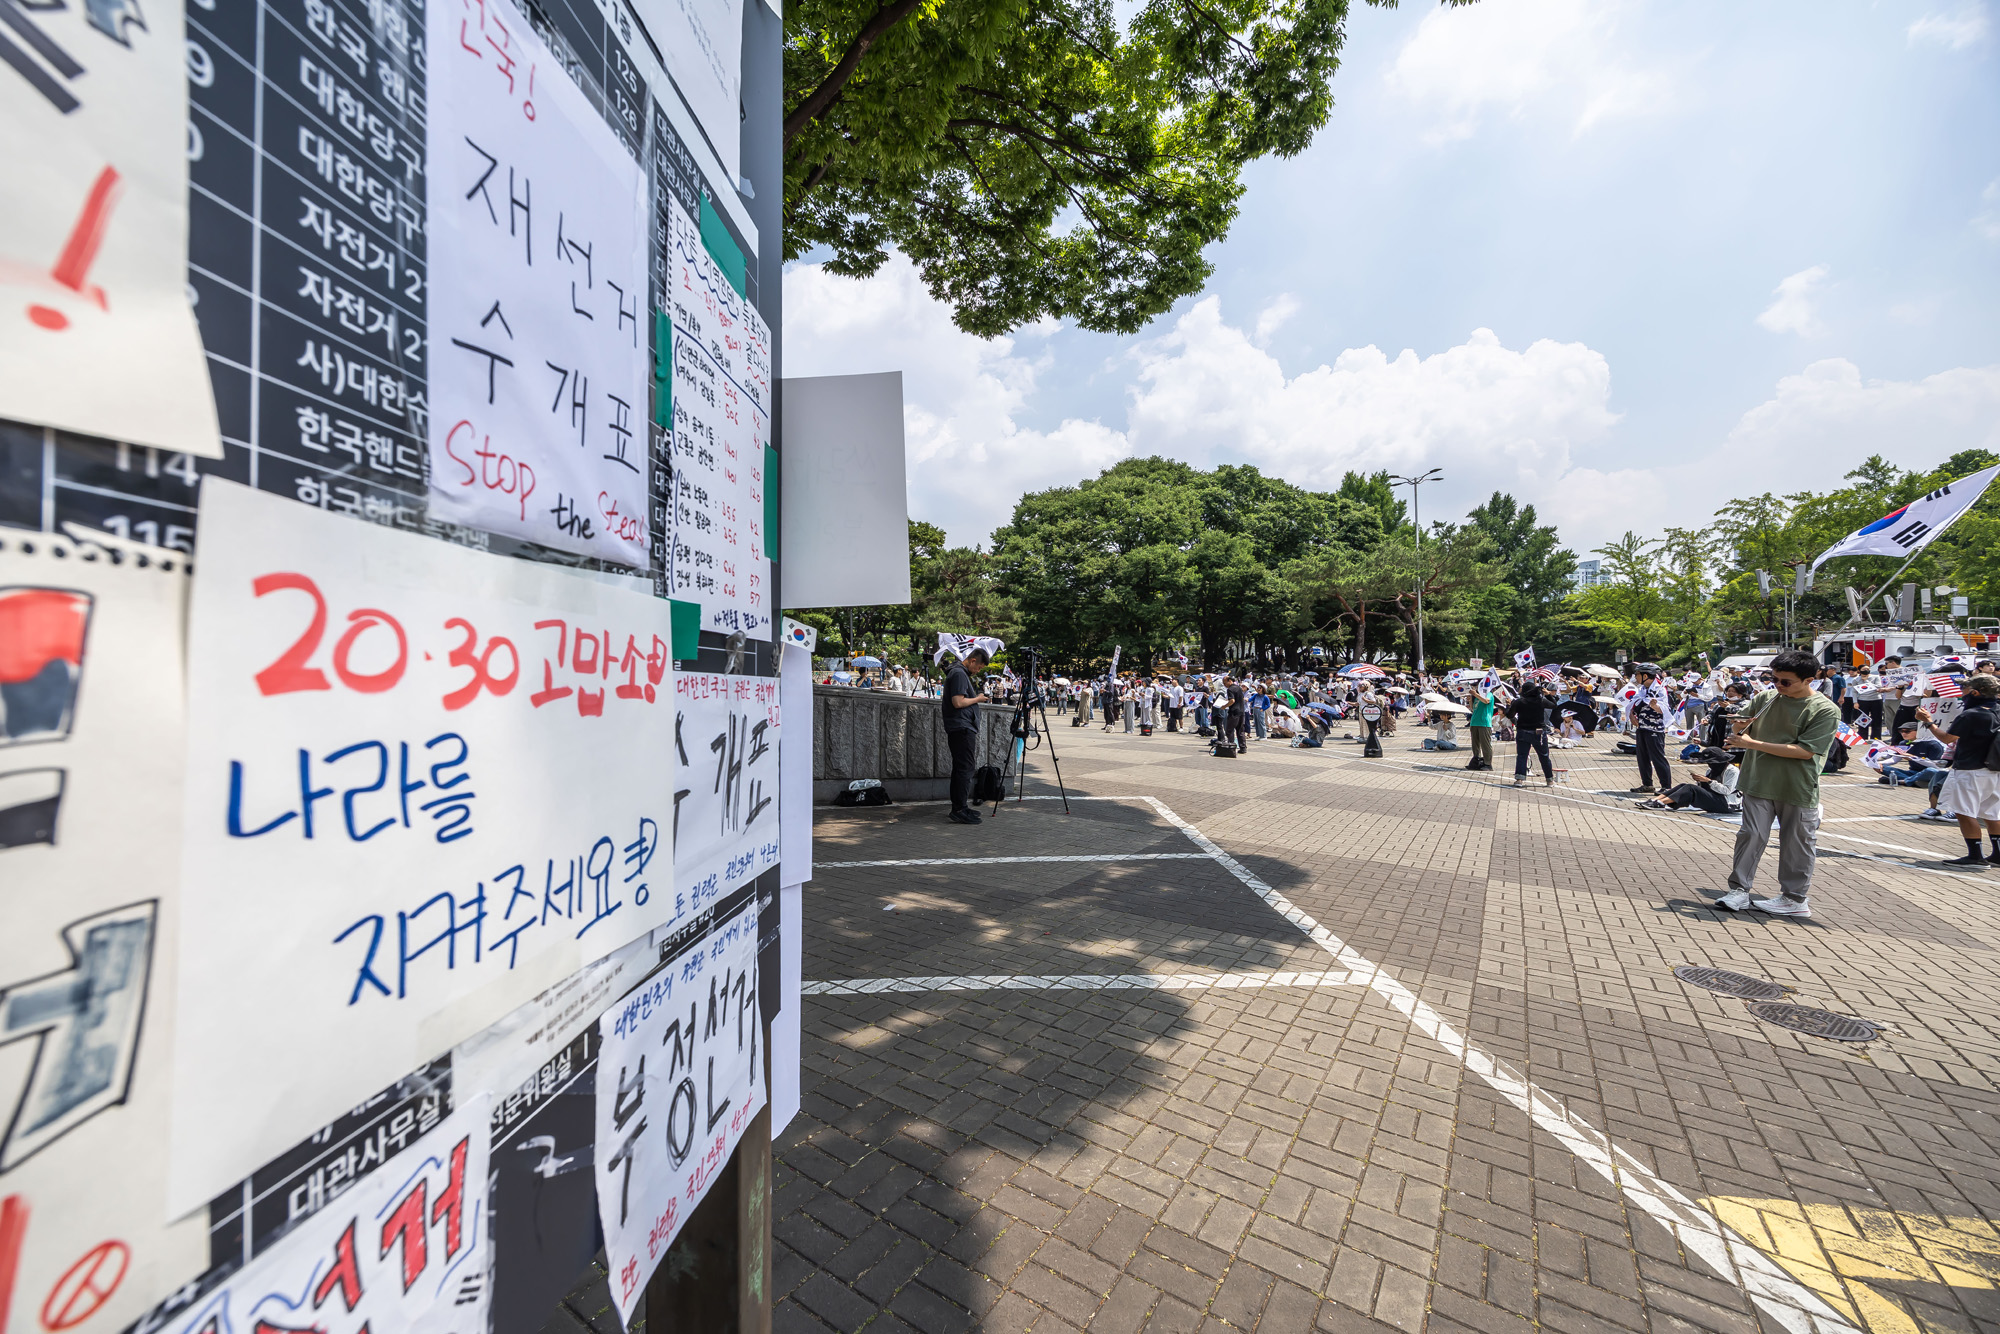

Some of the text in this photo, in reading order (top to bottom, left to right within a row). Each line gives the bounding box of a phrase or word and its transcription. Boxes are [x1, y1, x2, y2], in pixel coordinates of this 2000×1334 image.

[614, 50, 638, 94] 125
[299, 55, 428, 181] 대한당구
[614, 89, 638, 132] 126
[298, 124, 428, 241] 대한당구
[656, 148, 700, 224] 대관사무실
[657, 112, 700, 191] 대관사무실
[298, 195, 428, 304] 자전거 2
[464, 135, 638, 350] 재선거
[676, 214, 698, 263] 다른
[297, 265, 428, 363] 자전거 2
[451, 300, 641, 474] 수개표
[724, 381, 738, 405] 506
[725, 402, 739, 426] 506
[296, 405, 430, 488] 한국핸드
[446, 419, 536, 521] Stop
[550, 492, 595, 541] the
[724, 439, 738, 462] 1401
[750, 465, 761, 482] 120
[724, 466, 737, 486] 1401
[750, 485, 761, 503] 120
[750, 574, 761, 588] 57
[750, 591, 761, 608] 57
[677, 674, 729, 700] 대한민국의
[226, 732, 476, 844] 나라를
[691, 873, 719, 911] 권력은
[660, 920, 698, 953] 관사무실
[614, 972, 674, 1041] 대한민국의
[608, 951, 758, 1229] 부정선거
[288, 1088, 442, 1222] 대관사무실
